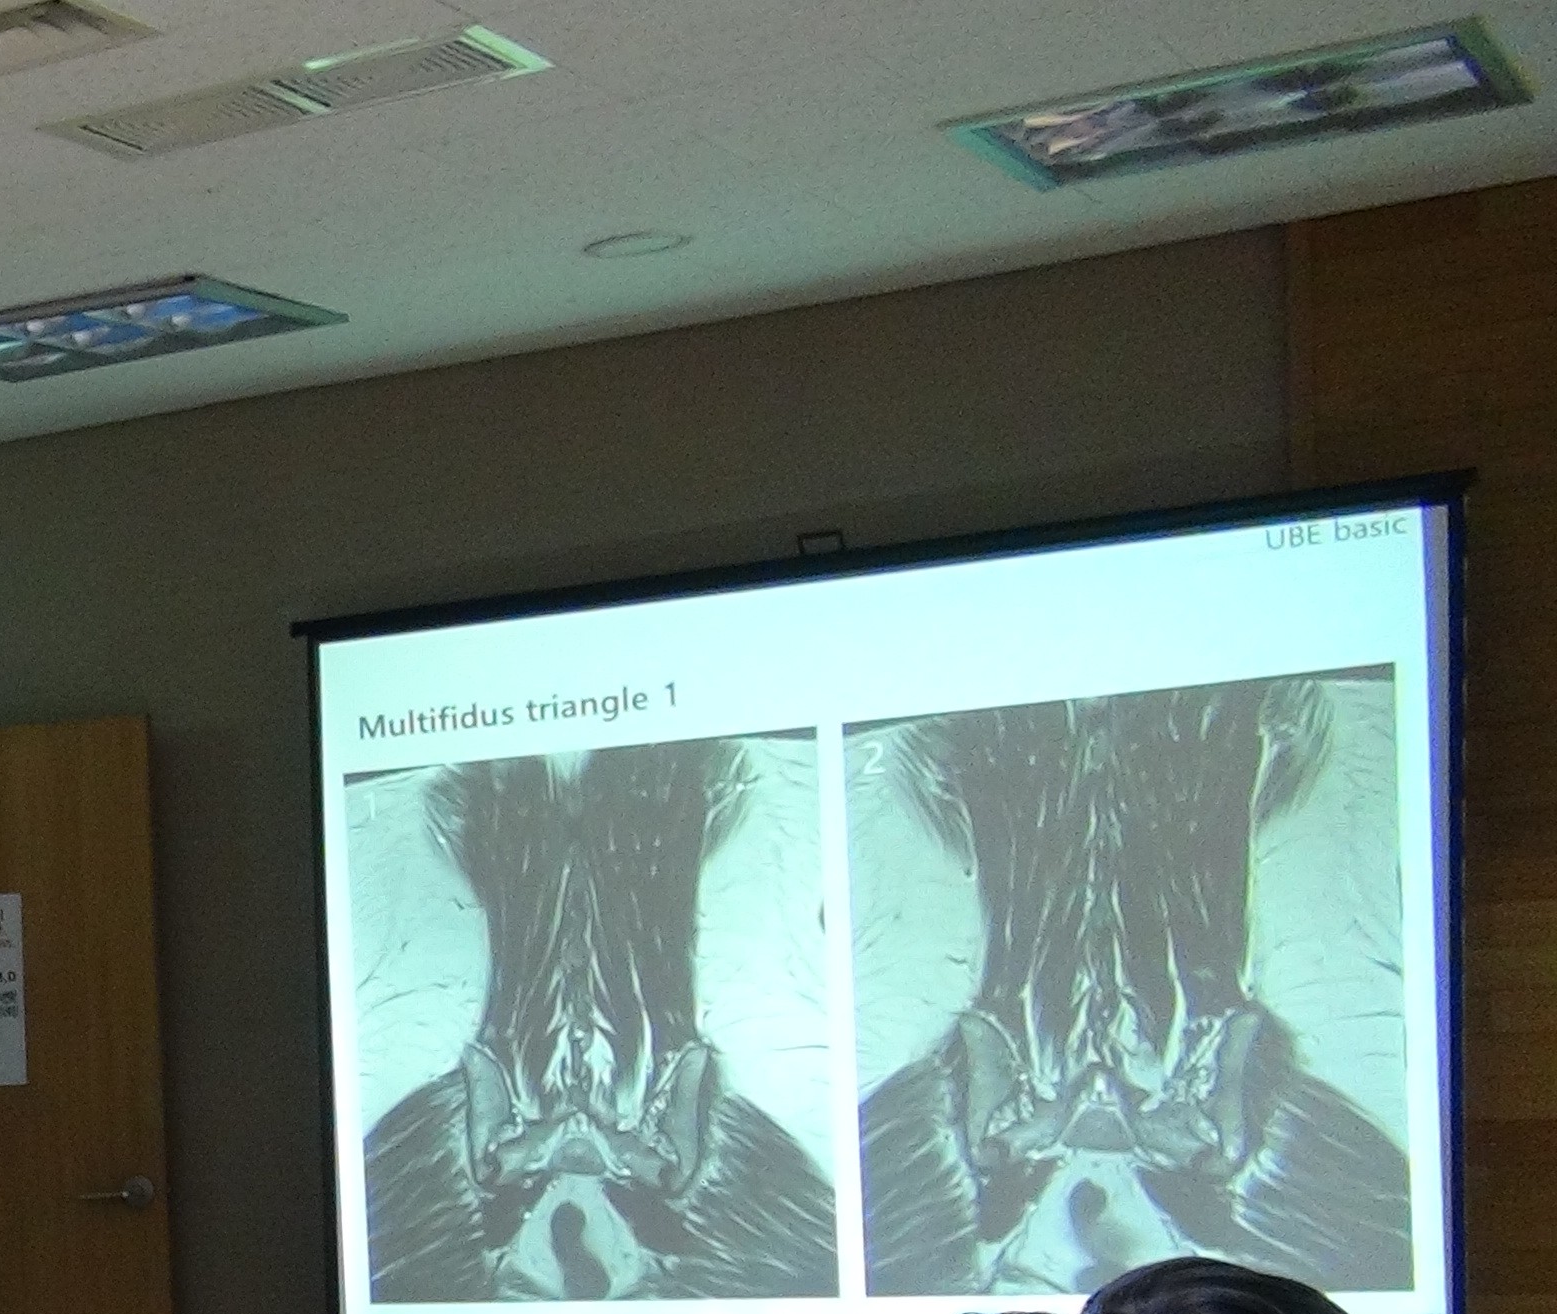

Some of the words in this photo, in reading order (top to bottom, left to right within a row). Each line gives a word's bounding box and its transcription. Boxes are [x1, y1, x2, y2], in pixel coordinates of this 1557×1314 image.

[1265, 523, 1322, 551] UBE
[1334, 516, 1408, 542] basic
[358, 702, 515, 740] Multifidus
[526, 685, 649, 722] triangle
[665, 681, 677, 708] 1
[857, 740, 887, 776] 2
